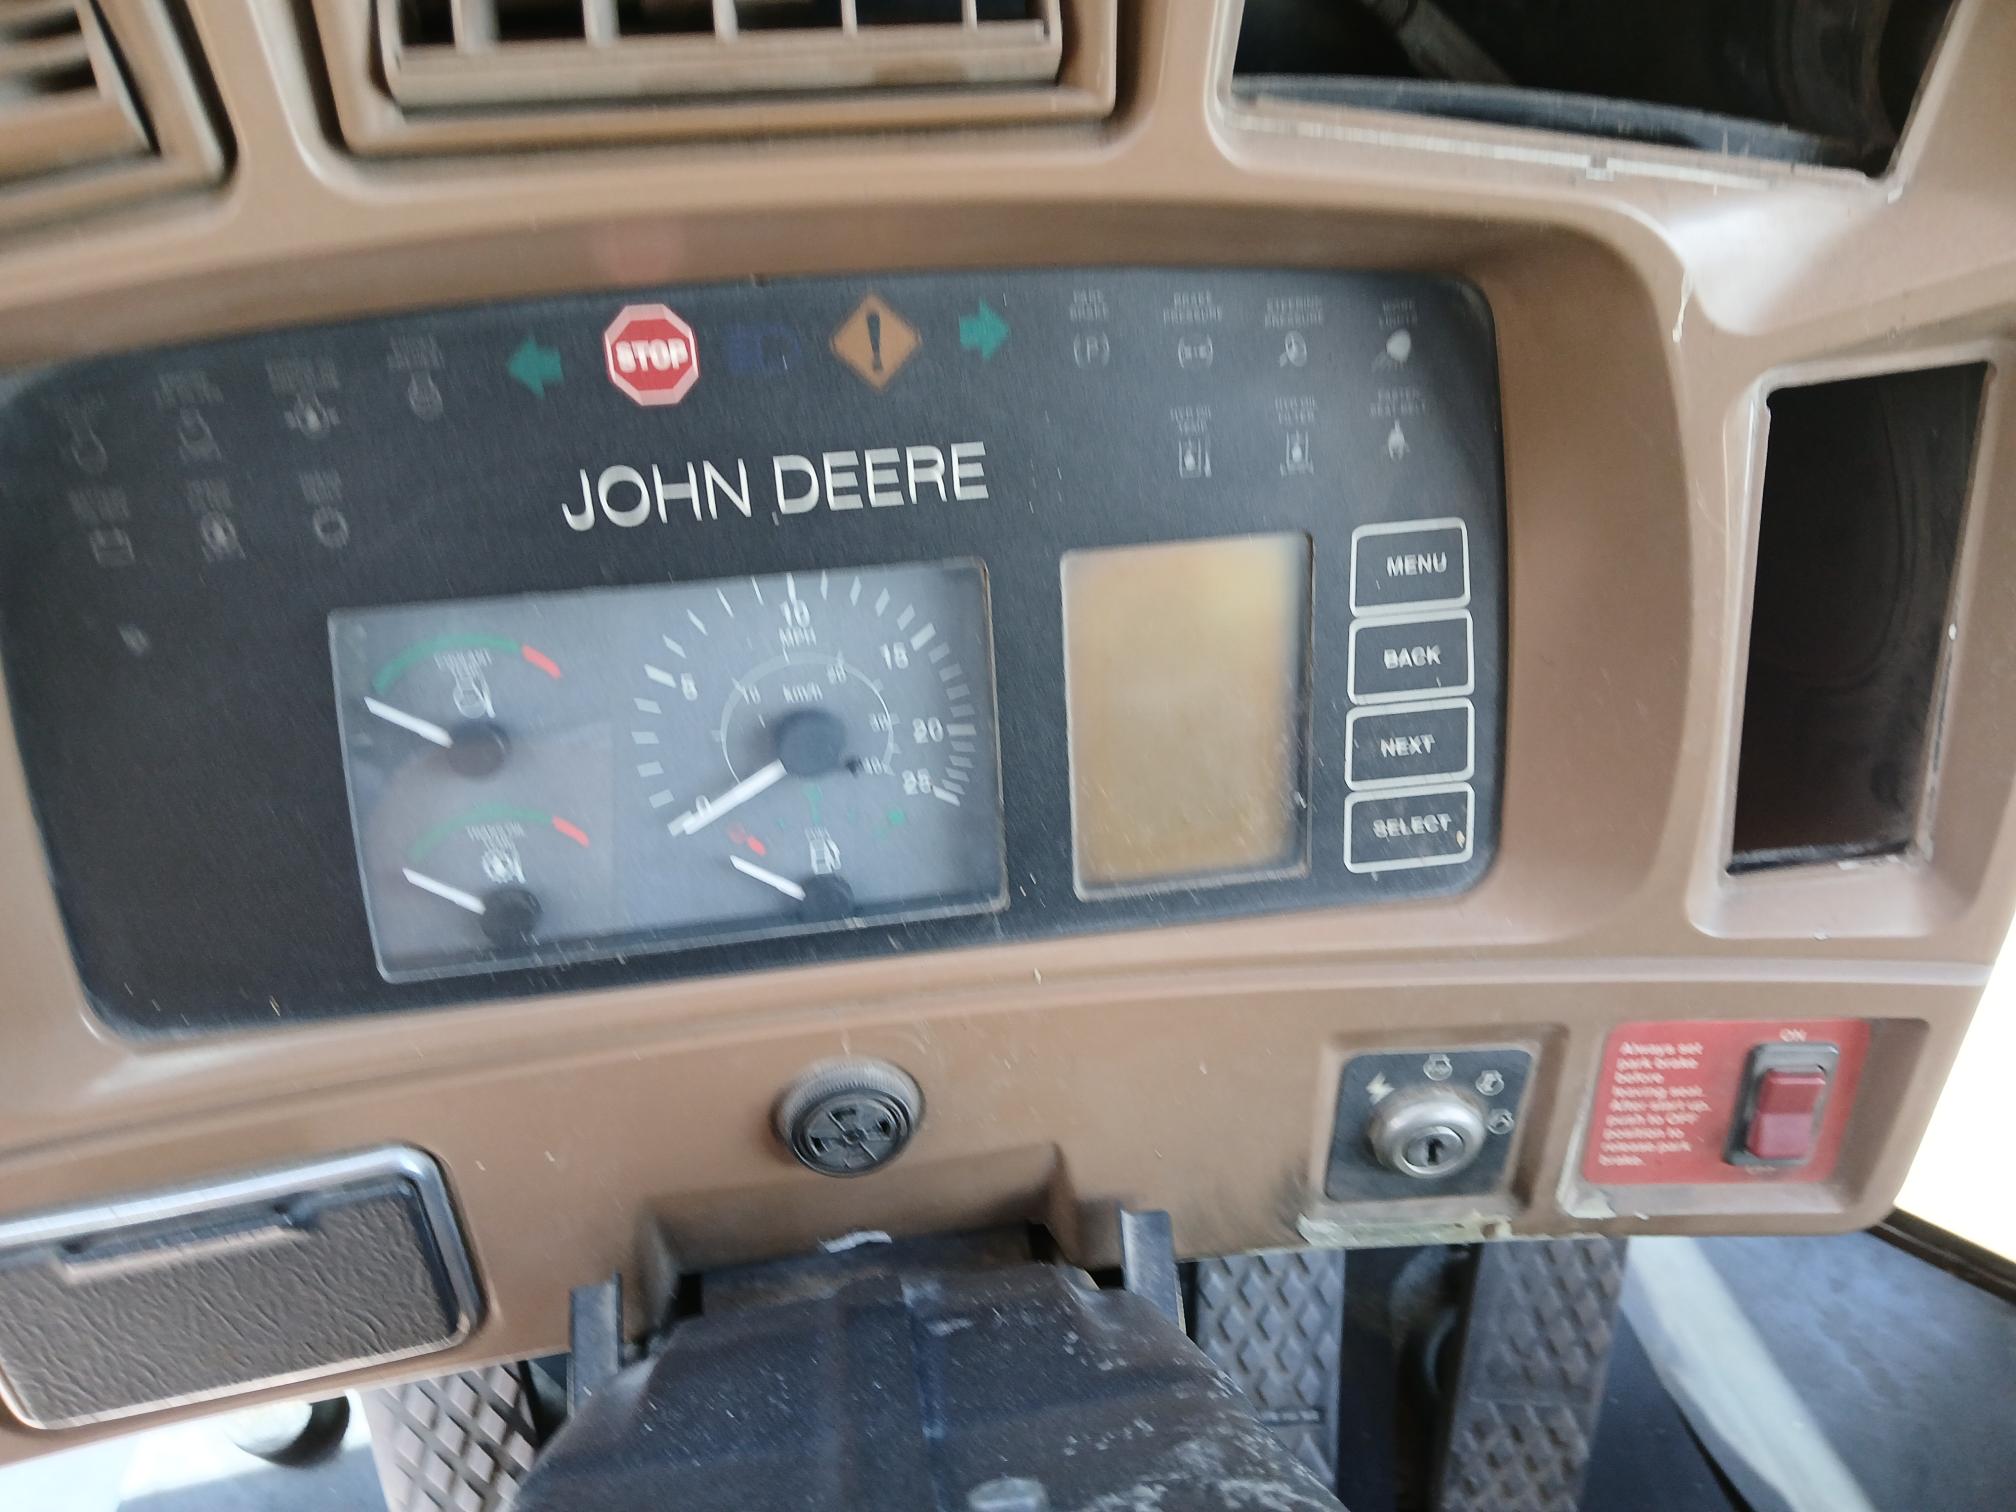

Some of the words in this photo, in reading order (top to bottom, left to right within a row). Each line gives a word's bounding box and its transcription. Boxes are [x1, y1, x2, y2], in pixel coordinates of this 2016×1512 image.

[614, 338, 689, 373] STOP
[561, 457, 752, 531] JOHN
[772, 441, 989, 516] DEERE
[1385, 552, 1448, 577] MENU
[781, 599, 811, 628] 10
[1383, 645, 1442, 670] BACK
[912, 716, 945, 744] 20
[1379, 733, 1436, 758] NEXT
[1372, 812, 1453, 839] SELECT
[1779, 1028, 1807, 1042] ON
